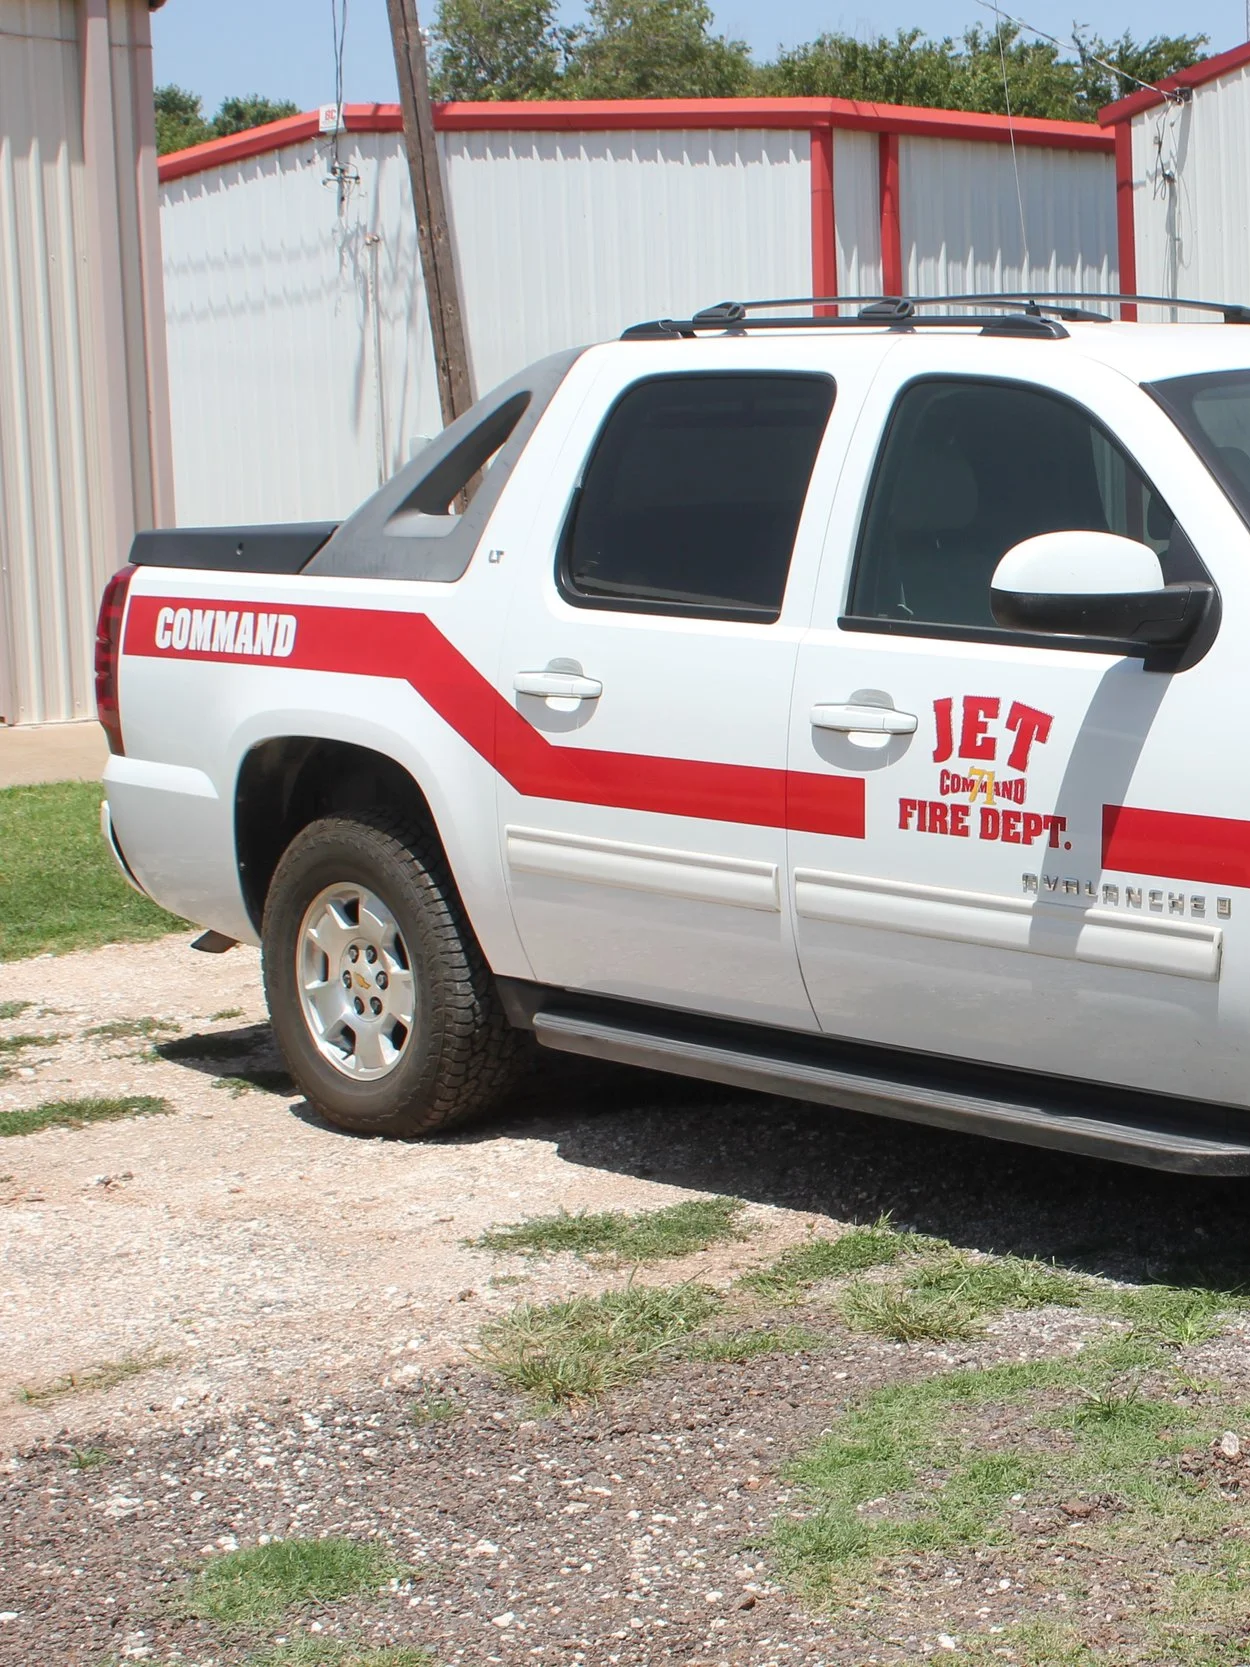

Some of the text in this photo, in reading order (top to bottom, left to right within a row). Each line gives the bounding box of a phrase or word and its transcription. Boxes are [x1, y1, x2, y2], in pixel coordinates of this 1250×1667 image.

[488, 549, 505, 564] LT
[155, 606, 297, 658] COMMAND
[932, 695, 1054, 772] JET
[967, 766, 996, 805] 71
[898, 798, 1072, 850] FIRE DEPT.
[1021, 873, 1206, 915] AVALANCHE
